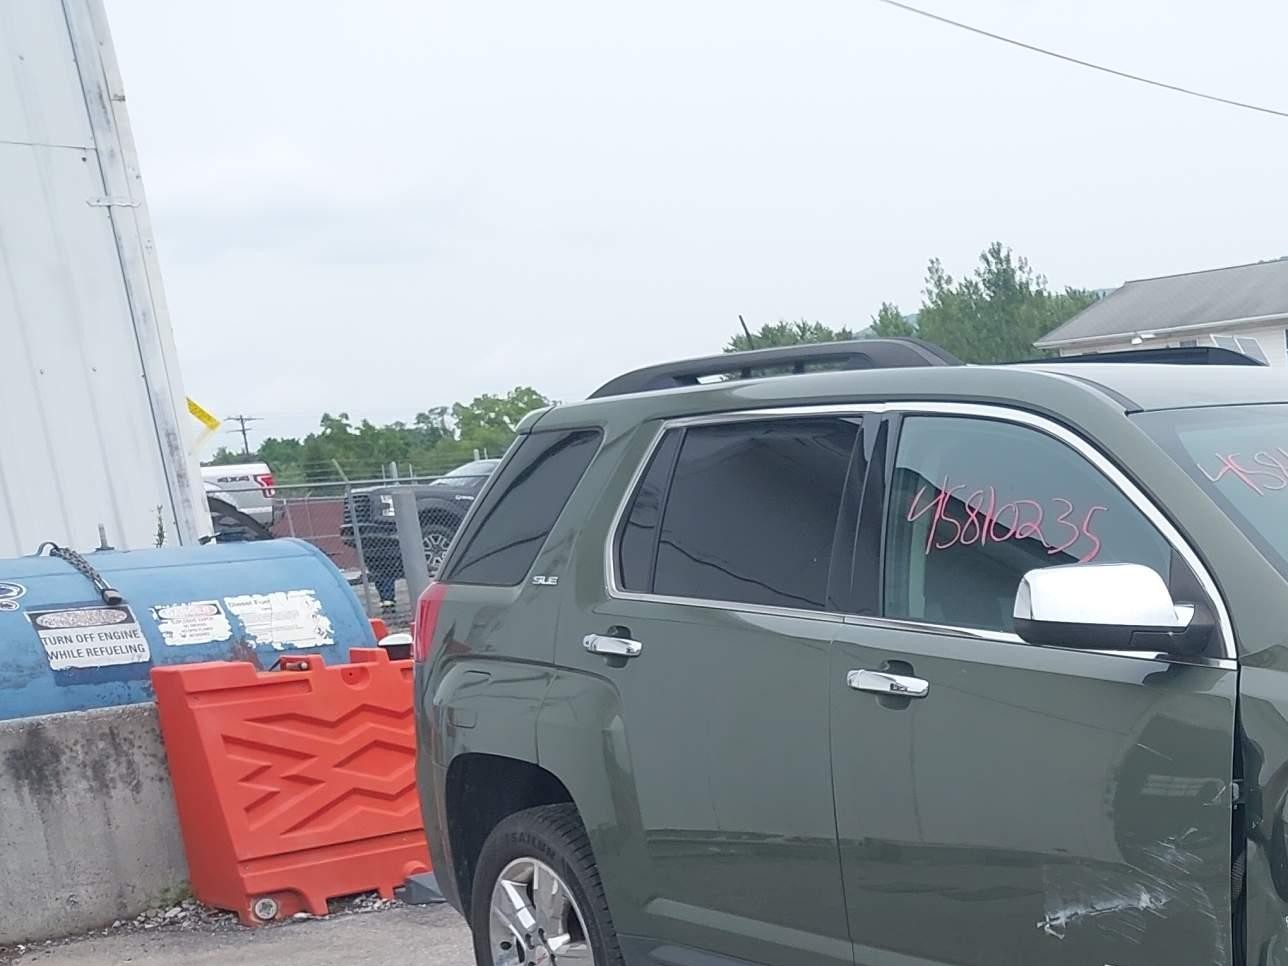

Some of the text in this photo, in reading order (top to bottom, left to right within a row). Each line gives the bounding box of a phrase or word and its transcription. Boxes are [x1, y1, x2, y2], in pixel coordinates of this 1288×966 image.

[907, 474, 1109, 564] 45810235
[531, 575, 559, 585] SLE
[41, 629, 140, 647] TURN OFF ENGINE
[48, 643, 146, 660] WHILE REFUELING
